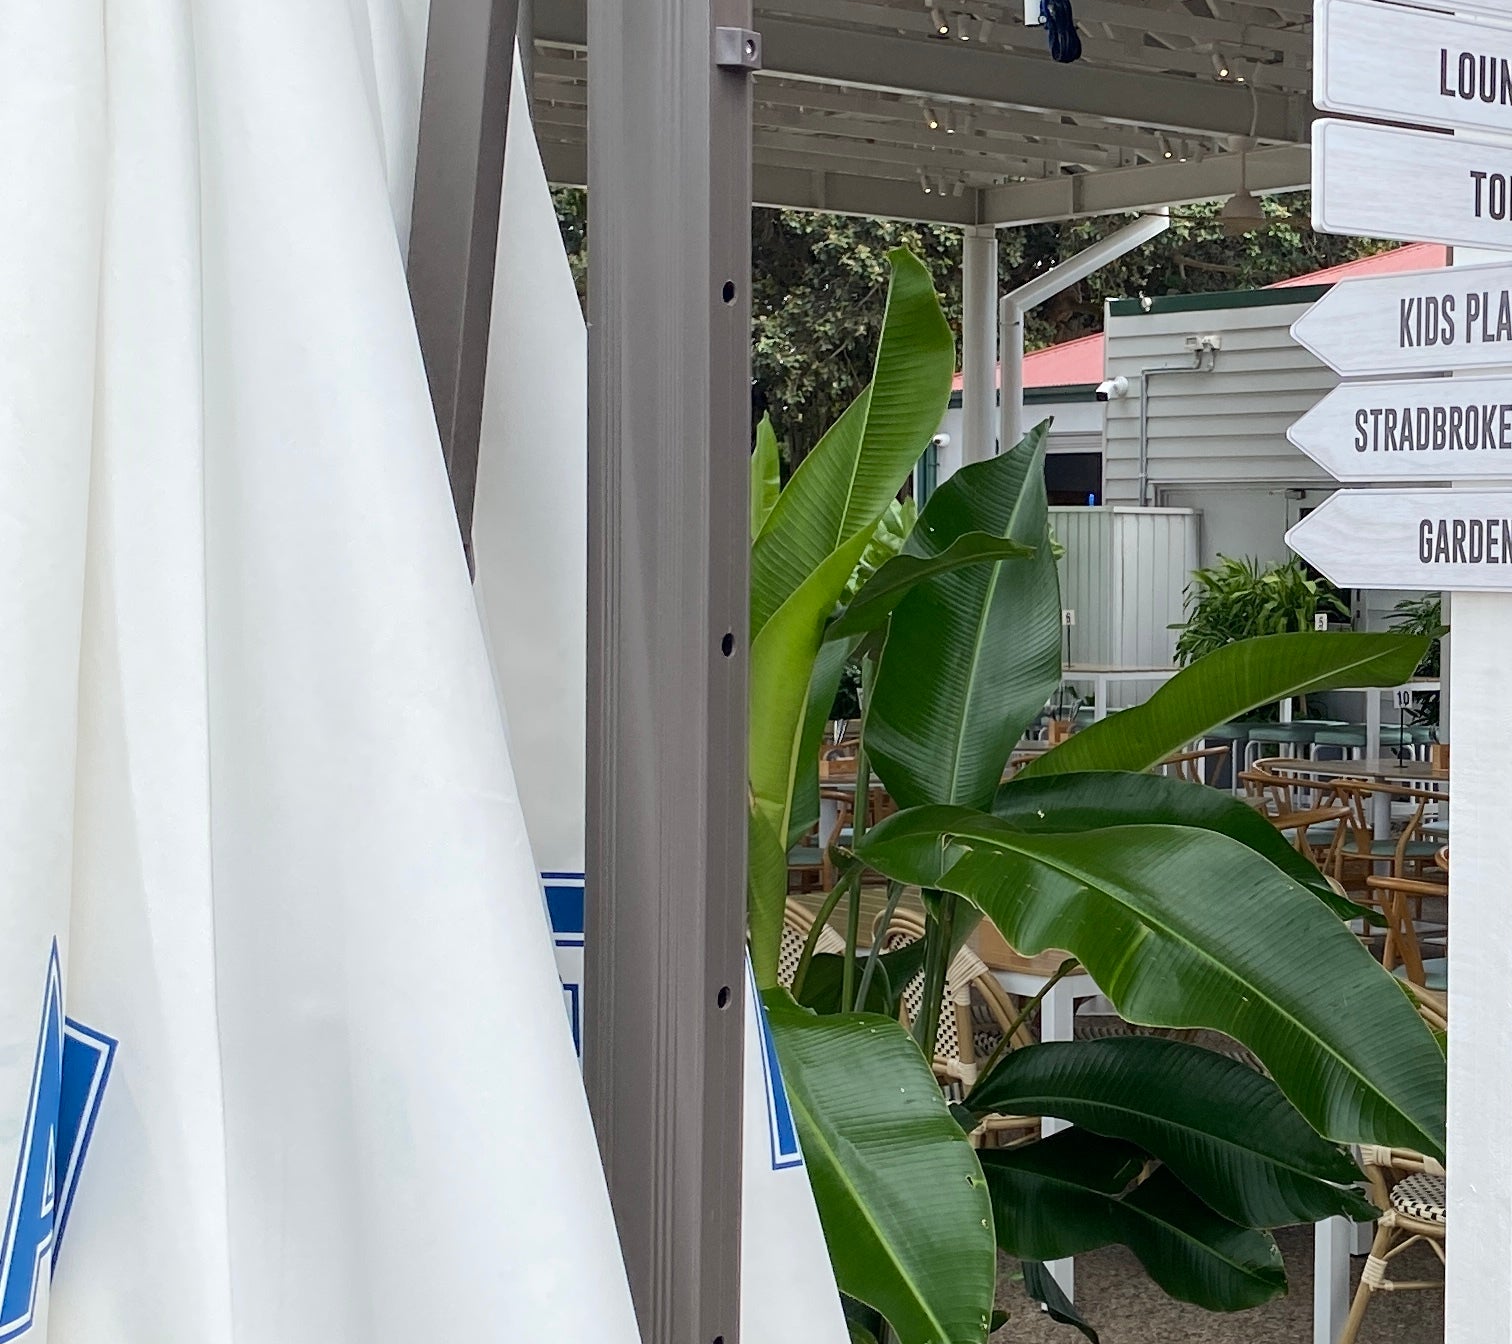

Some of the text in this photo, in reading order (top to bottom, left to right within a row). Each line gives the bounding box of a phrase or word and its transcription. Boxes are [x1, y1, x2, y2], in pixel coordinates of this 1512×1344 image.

[1399, 294, 1455, 348] KIDS
[1354, 404, 1512, 453] STRADBROKE
[1397, 690, 1410, 706] 10
